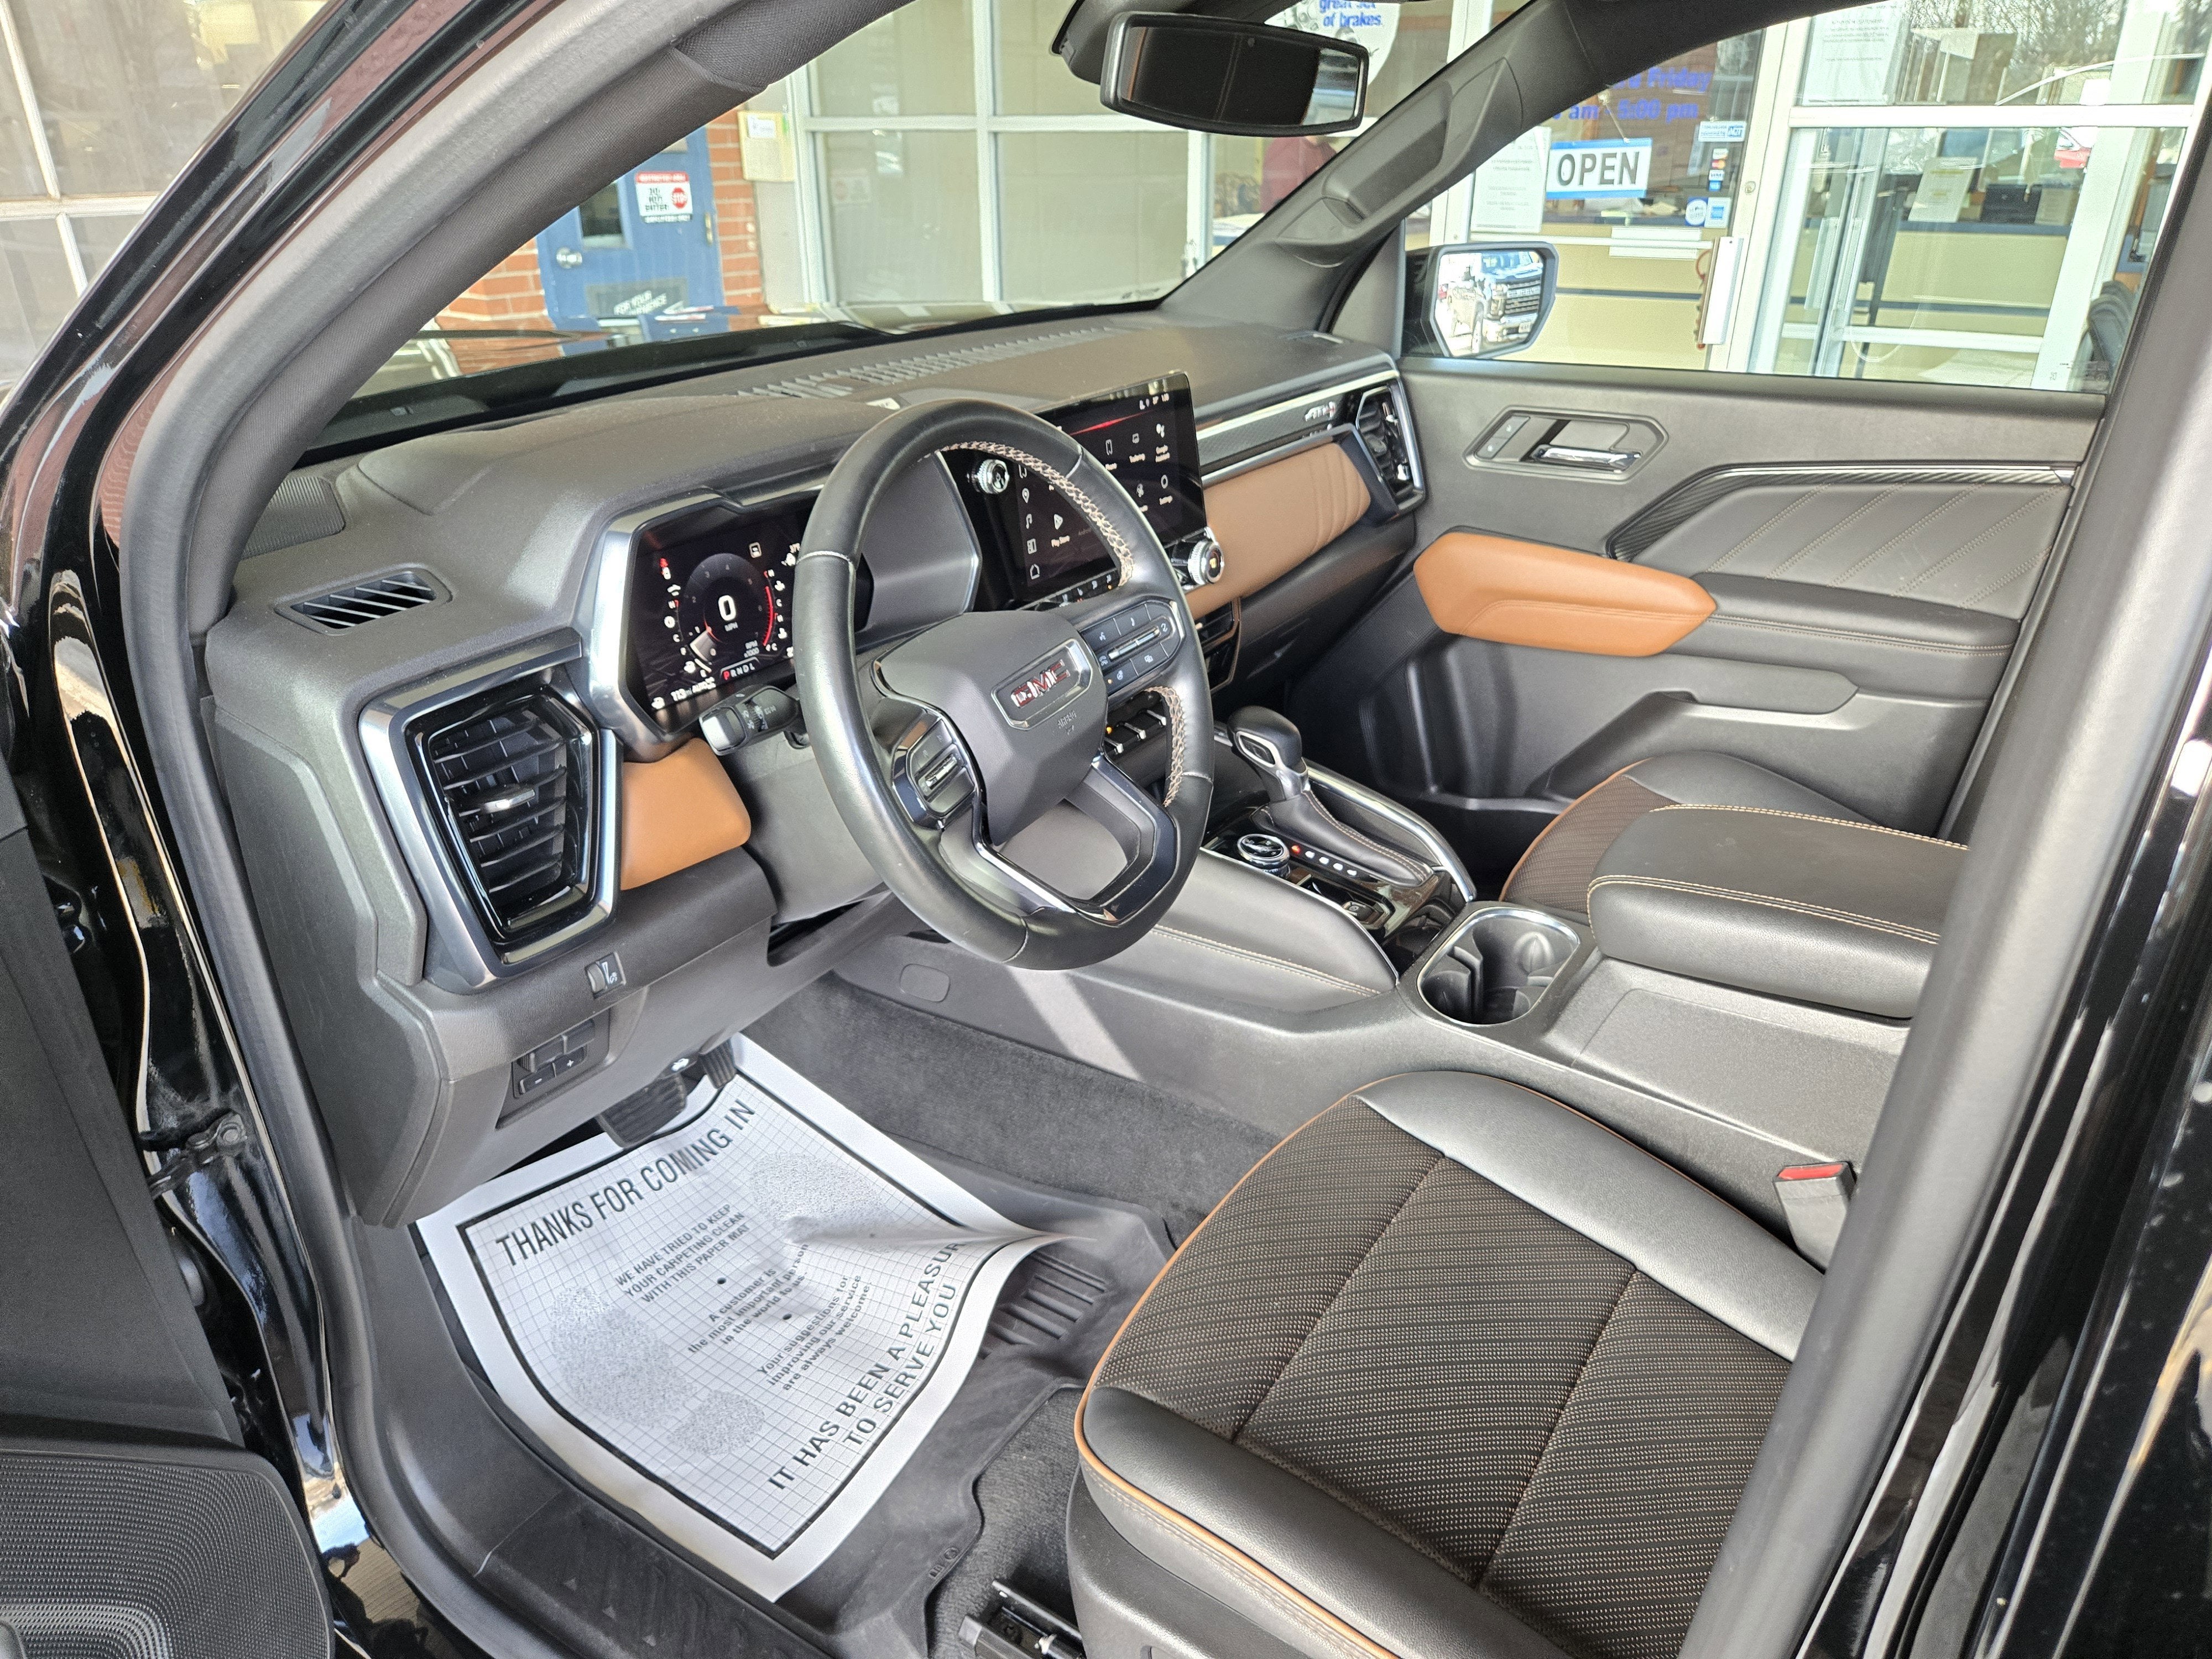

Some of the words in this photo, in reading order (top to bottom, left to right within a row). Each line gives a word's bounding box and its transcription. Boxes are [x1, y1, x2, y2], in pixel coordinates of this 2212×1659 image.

[1323, 12, 1335, 27] of
[1568, 105, 1599, 120] am
[1617, 98, 1660, 120] 5:00
[1665, 103, 1699, 124] pm
[1647, 66, 1713, 93] Friday
[1556, 150, 1640, 186] OPEN
[718, 594, 737, 622] 0
[1010, 659, 1071, 708] GMC
[495, 1201, 593, 1266] THANKS
[590, 1177, 644, 1220] FOR
[640, 1128, 733, 1192] COMING
[724, 1098, 756, 1130] IN
[615, 1270, 635, 1286] WE
[633, 1251, 662, 1274] HAVE
[660, 1232, 693, 1255] TRIED
[691, 1222, 708, 1234] TO
[706, 1203, 732, 1224] KEEP
[624, 1274, 658, 1297] YOUR
[656, 1235, 713, 1276] CARPETING
[712, 1212, 745, 1237] CLEAN
[641, 1280, 672, 1302] WITH
[670, 1263, 697, 1282] THIS
[694, 1239, 729, 1265] PAPER
[727, 1223, 750, 1241] MAT
[687, 1338, 708, 1353] the
[708, 1316, 735, 1339] most
[734, 1279, 784, 1317] important
[782, 1244, 809, 1281] person
[708, 1313, 720, 1322] A
[718, 1276, 765, 1314] customer
[763, 1268, 777, 1277] is
[719, 1334, 735, 1345] in
[732, 1318, 752, 1334] the
[751, 1295, 782, 1318] world
[778, 1287, 792, 1296] to
[757, 1352, 785, 1375] Your
[783, 1295, 840, 1353] suggestions
[836, 1276, 848, 1292] for
[766, 1335, 821, 1386] improving
[818, 1318, 837, 1335] our
[836, 1275, 862, 1318] service
[782, 1373, 801, 1391] are
[800, 1337, 837, 1371] always
[842, 1417, 877, 1446] TO
[873, 1340, 935, 1413] SERVE
[924, 1283, 957, 1333] YOU
[768, 1465, 795, 1490] IT
[792, 1420, 841, 1467] HAS
[834, 1361, 892, 1417] BEEN
[886, 1345, 906, 1361] A
[898, 1243, 967, 1339] PLEASUR
